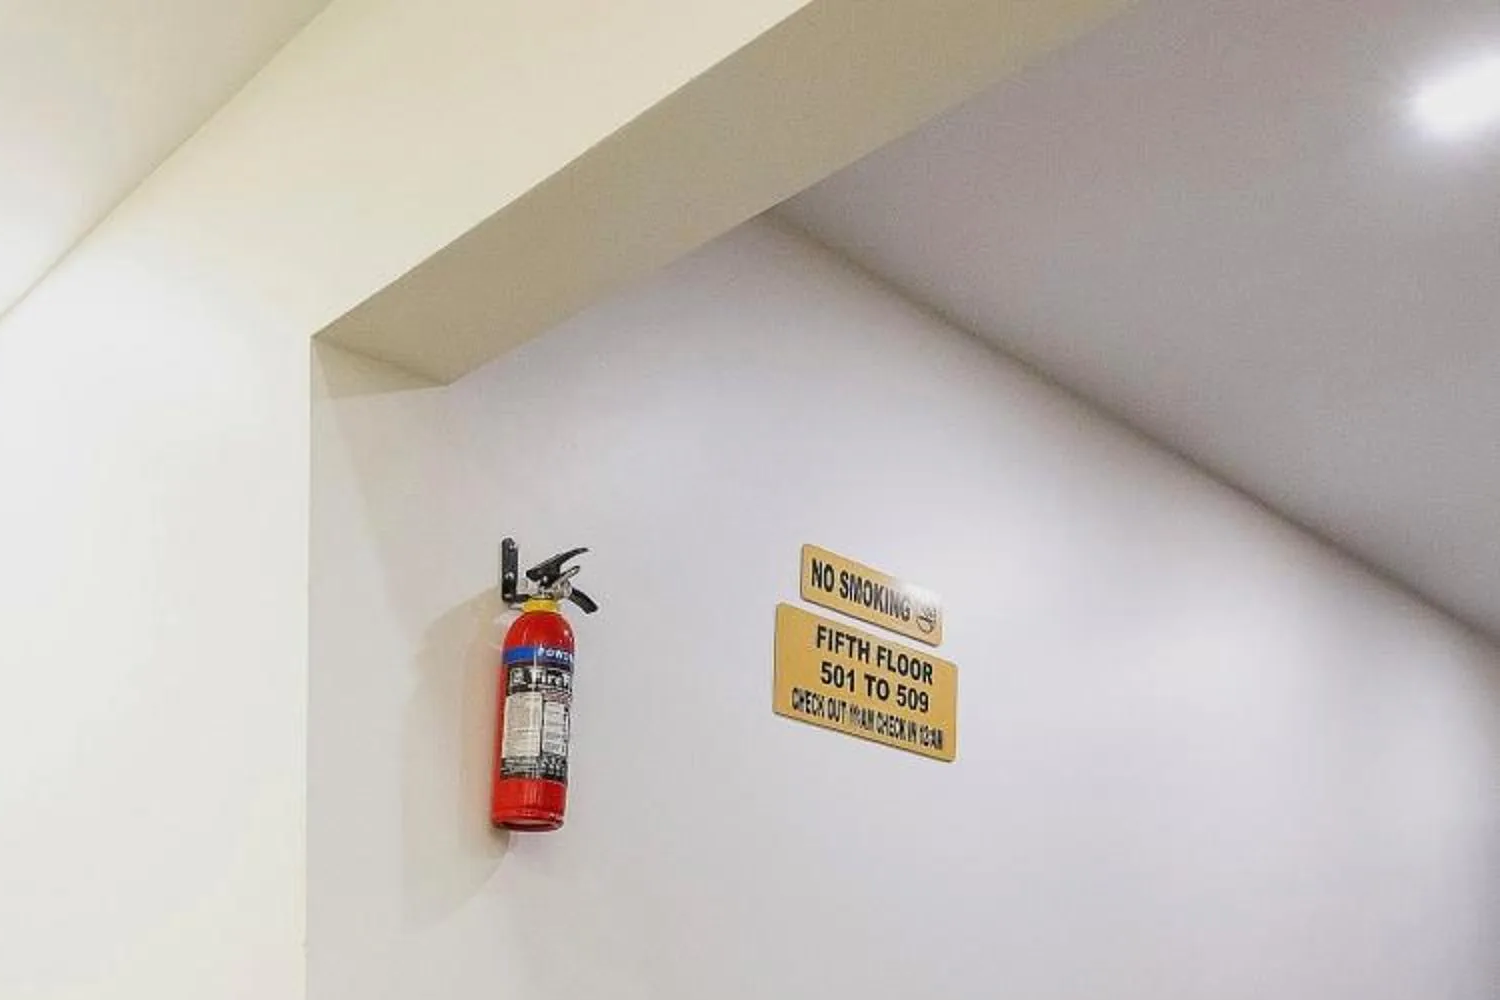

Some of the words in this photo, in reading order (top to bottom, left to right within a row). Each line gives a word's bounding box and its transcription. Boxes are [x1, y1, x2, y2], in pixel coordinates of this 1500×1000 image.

[811, 558, 835, 593] NO
[839, 569, 911, 622] SMOKING
[816, 624, 870, 665] FIFTH
[876, 645, 933, 686] FLOOR
[792, 687, 825, 719] CHECK
[828, 697, 846, 724] OUT
[876, 711, 906, 741] CHECK
[907, 720, 917, 745] IN
[821, 661, 855, 693] 501
[864, 672, 890, 701] TO
[896, 683, 929, 713] 509
